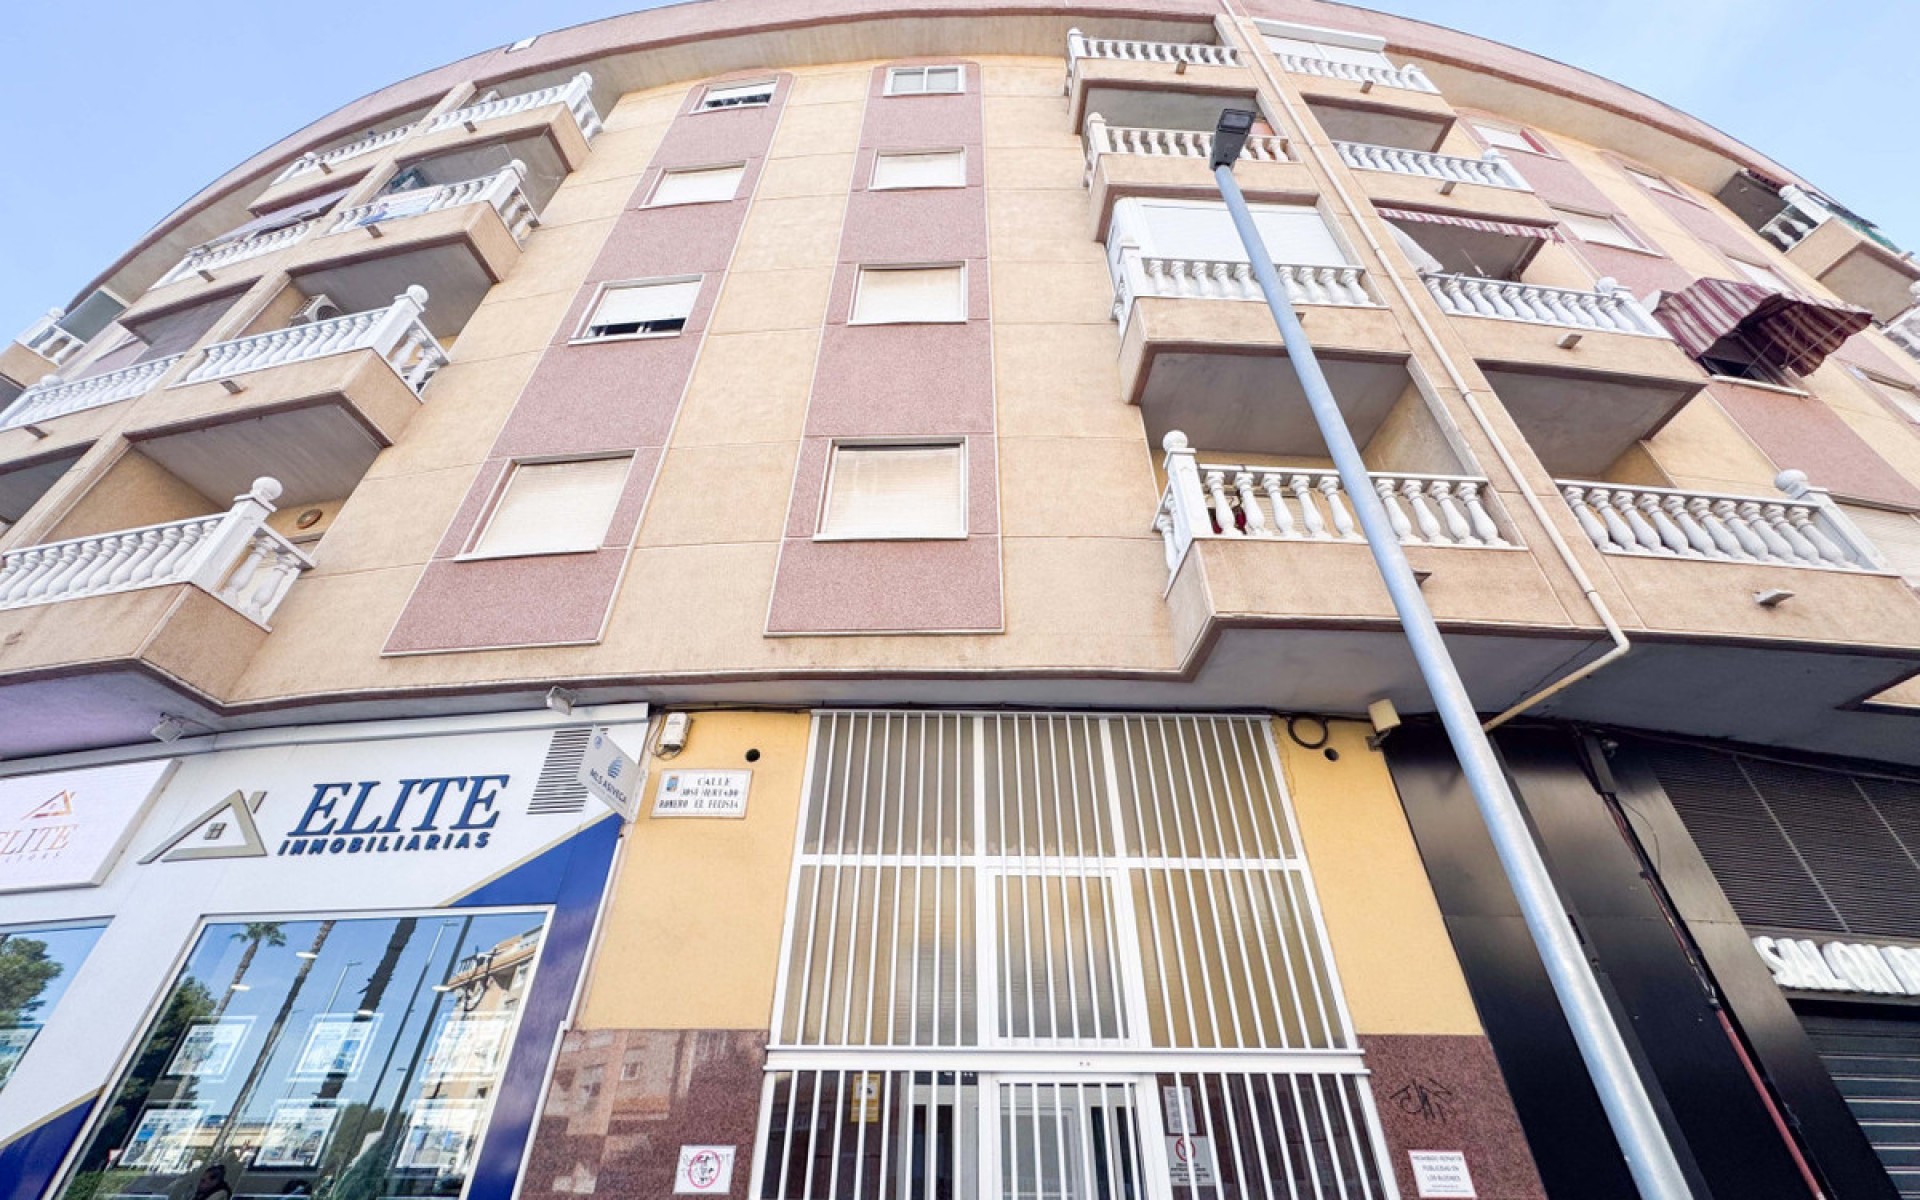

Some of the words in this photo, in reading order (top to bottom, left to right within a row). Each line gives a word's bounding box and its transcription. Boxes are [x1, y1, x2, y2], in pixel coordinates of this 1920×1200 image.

[697, 777, 731, 786] CALLE
[287, 774, 510, 836] ELITE
[277, 831, 491, 856] INMOBILIARIAS
